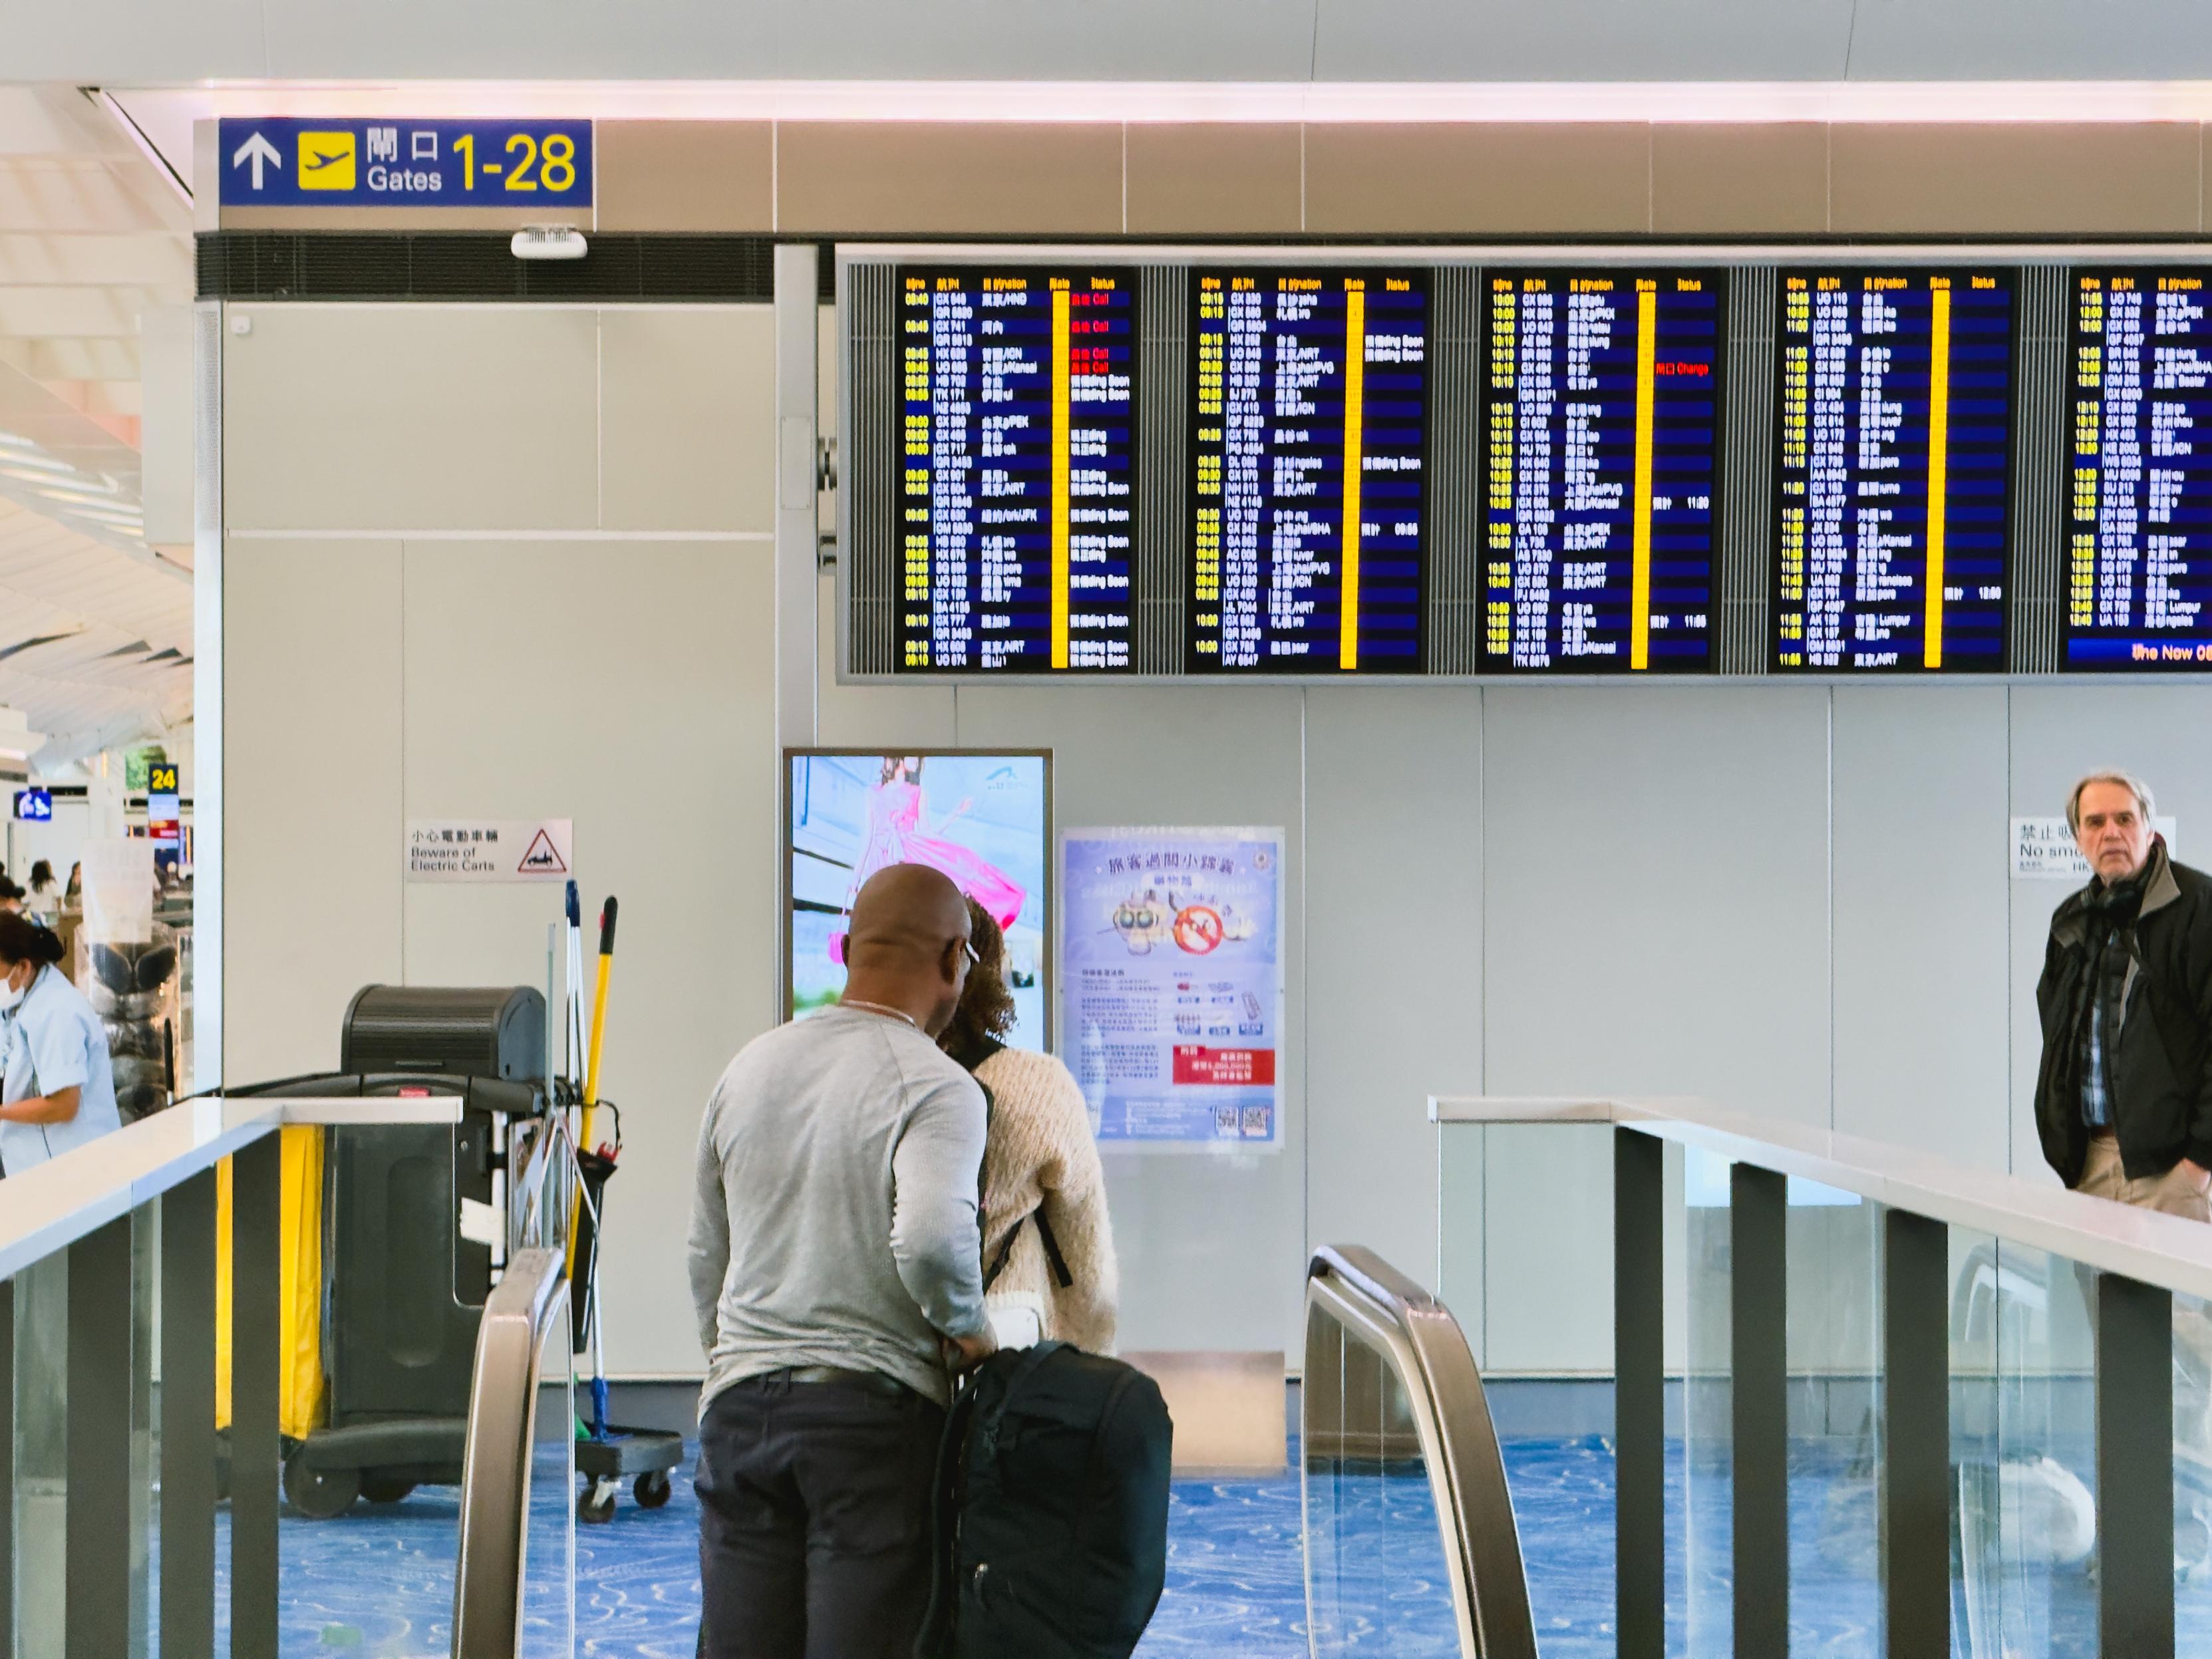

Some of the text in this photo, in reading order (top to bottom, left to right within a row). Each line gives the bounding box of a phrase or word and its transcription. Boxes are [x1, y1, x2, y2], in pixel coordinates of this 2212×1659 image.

[367, 128, 438, 162] 閘口
[453, 134, 576, 192] 1-28
[367, 166, 442, 192] Gates
[2162, 644, 2193, 661] Now
[152, 769, 176, 790] 24
[2020, 824, 2072, 841] 禁止吸
[411, 845, 476, 858] Beware of
[2020, 843, 2043, 857] No
[411, 860, 495, 872] Electric Carts
